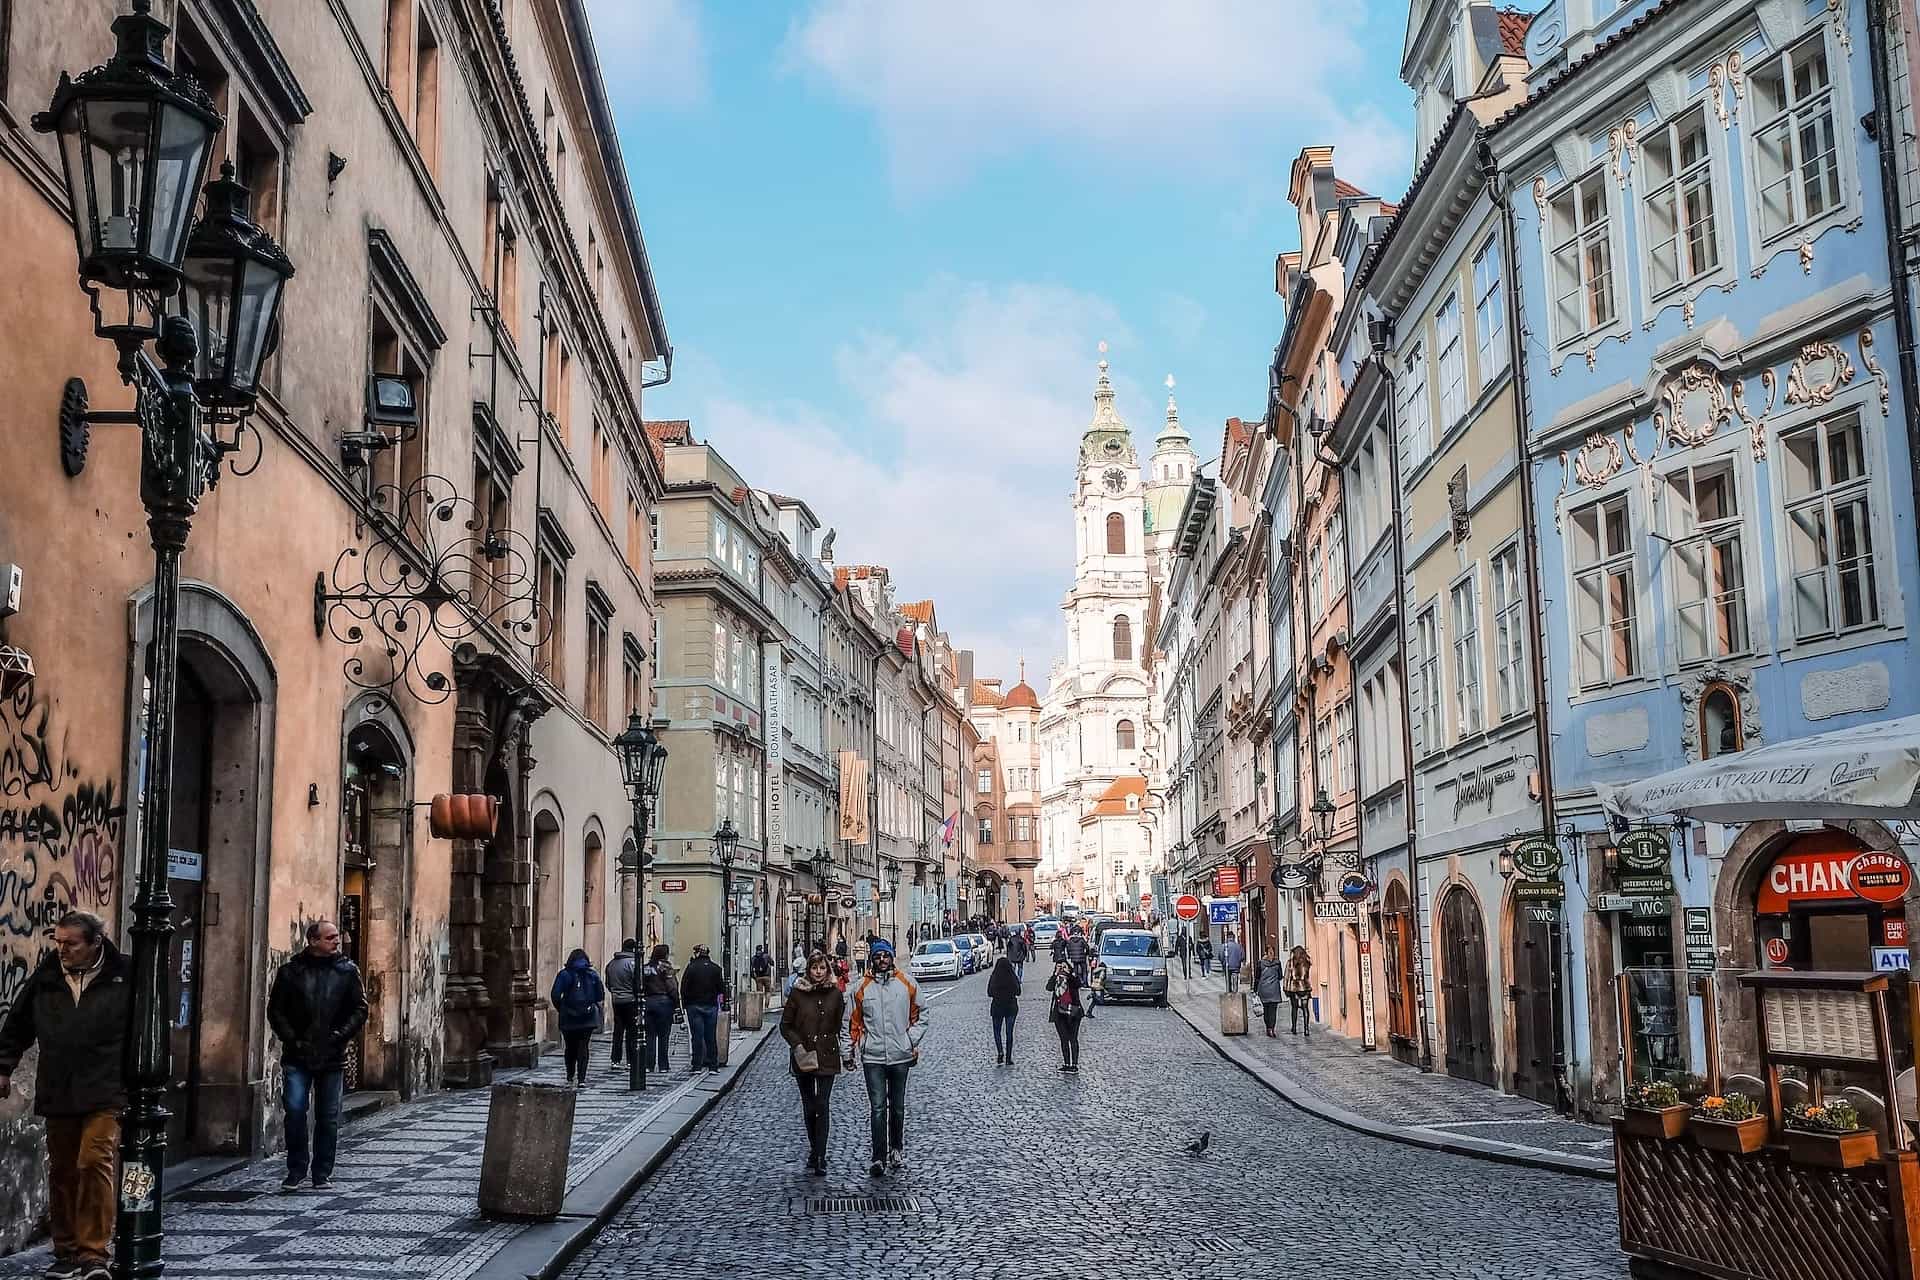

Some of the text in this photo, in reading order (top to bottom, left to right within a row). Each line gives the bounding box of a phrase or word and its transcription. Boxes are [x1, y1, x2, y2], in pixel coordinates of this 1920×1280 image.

[770, 720, 778, 758] DOMUS
[771, 773, 779, 811] HOTEL
[772, 814, 781, 853] DESIGN
[1856, 854, 1901, 871] change
[1315, 903, 1356, 917] CHANGE
[1533, 909, 1555, 922] WC
[1686, 934, 1713, 945] HOSTEL
